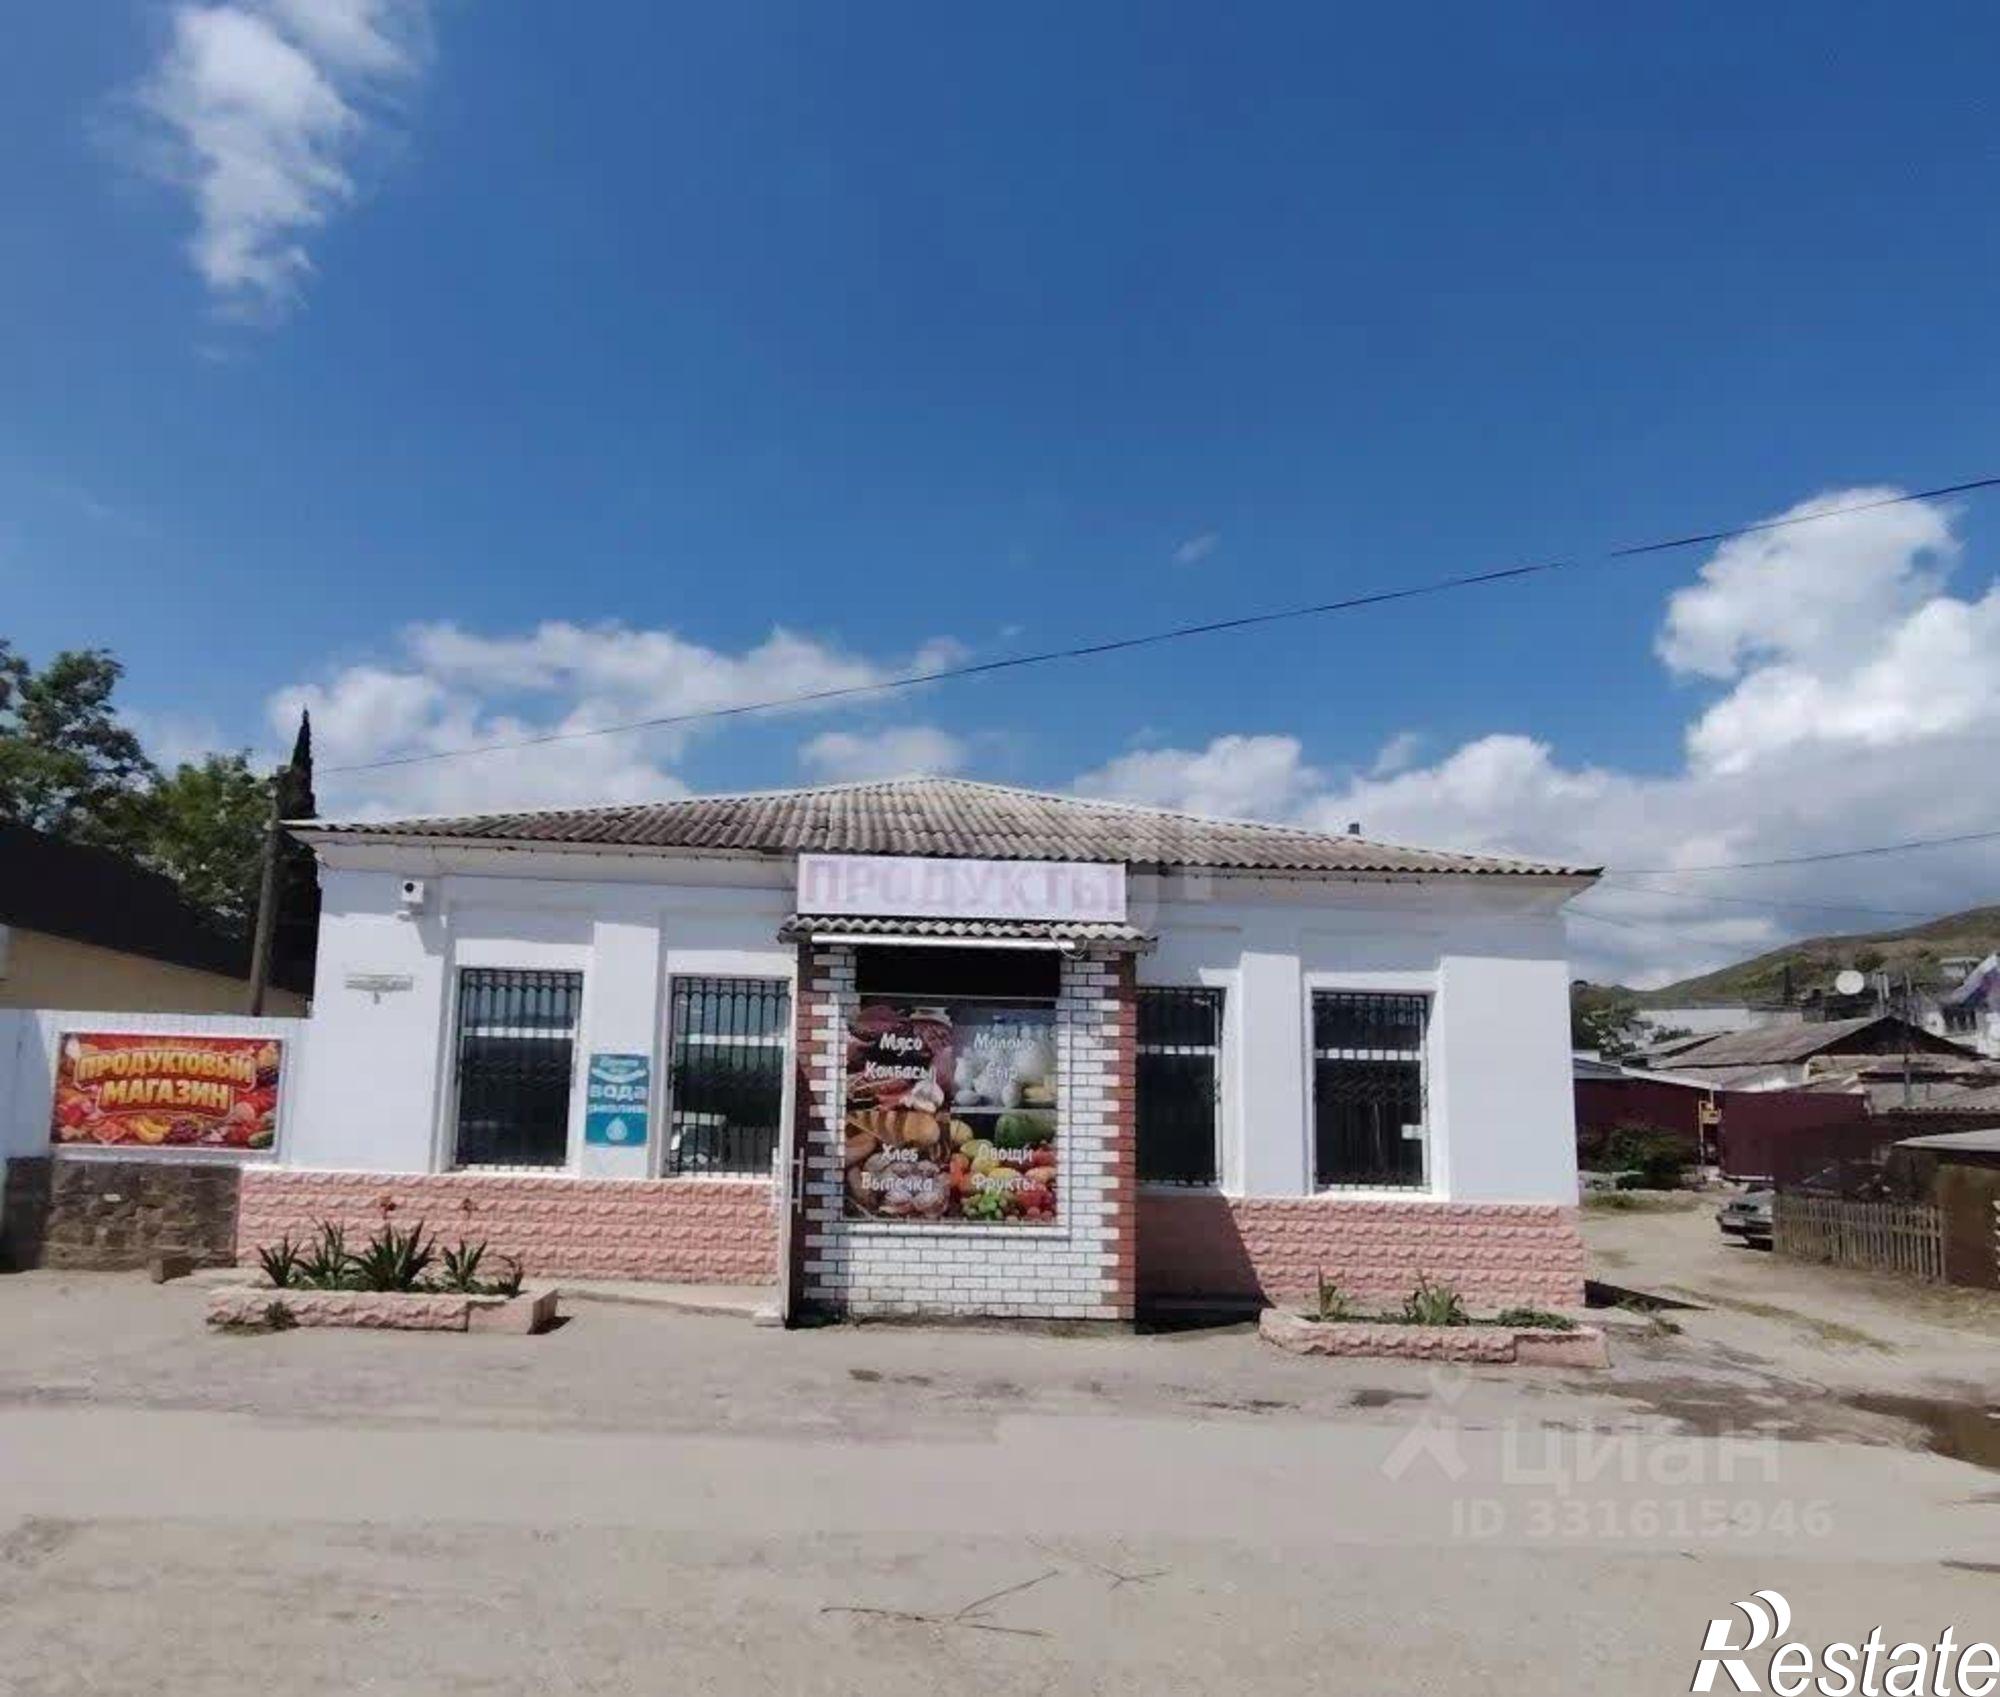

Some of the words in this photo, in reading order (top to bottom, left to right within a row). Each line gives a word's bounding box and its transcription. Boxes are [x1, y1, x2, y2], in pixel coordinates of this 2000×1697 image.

[806, 859, 1122, 914] ПРОДУКТЫ
[879, 1033, 923, 1056] Мясо
[973, 1032, 1035, 1050] Молоко
[77, 1050, 252, 1083] ПРОДУКТОВЫЙ
[103, 1078, 229, 1109] МАГАЗИН
[880, 1143, 918, 1162] Хлеб
[977, 1144, 1033, 1164] Овощи
[861, 1171, 933, 1191] Выпечка
[972, 1172, 1036, 1193] Фрукты
